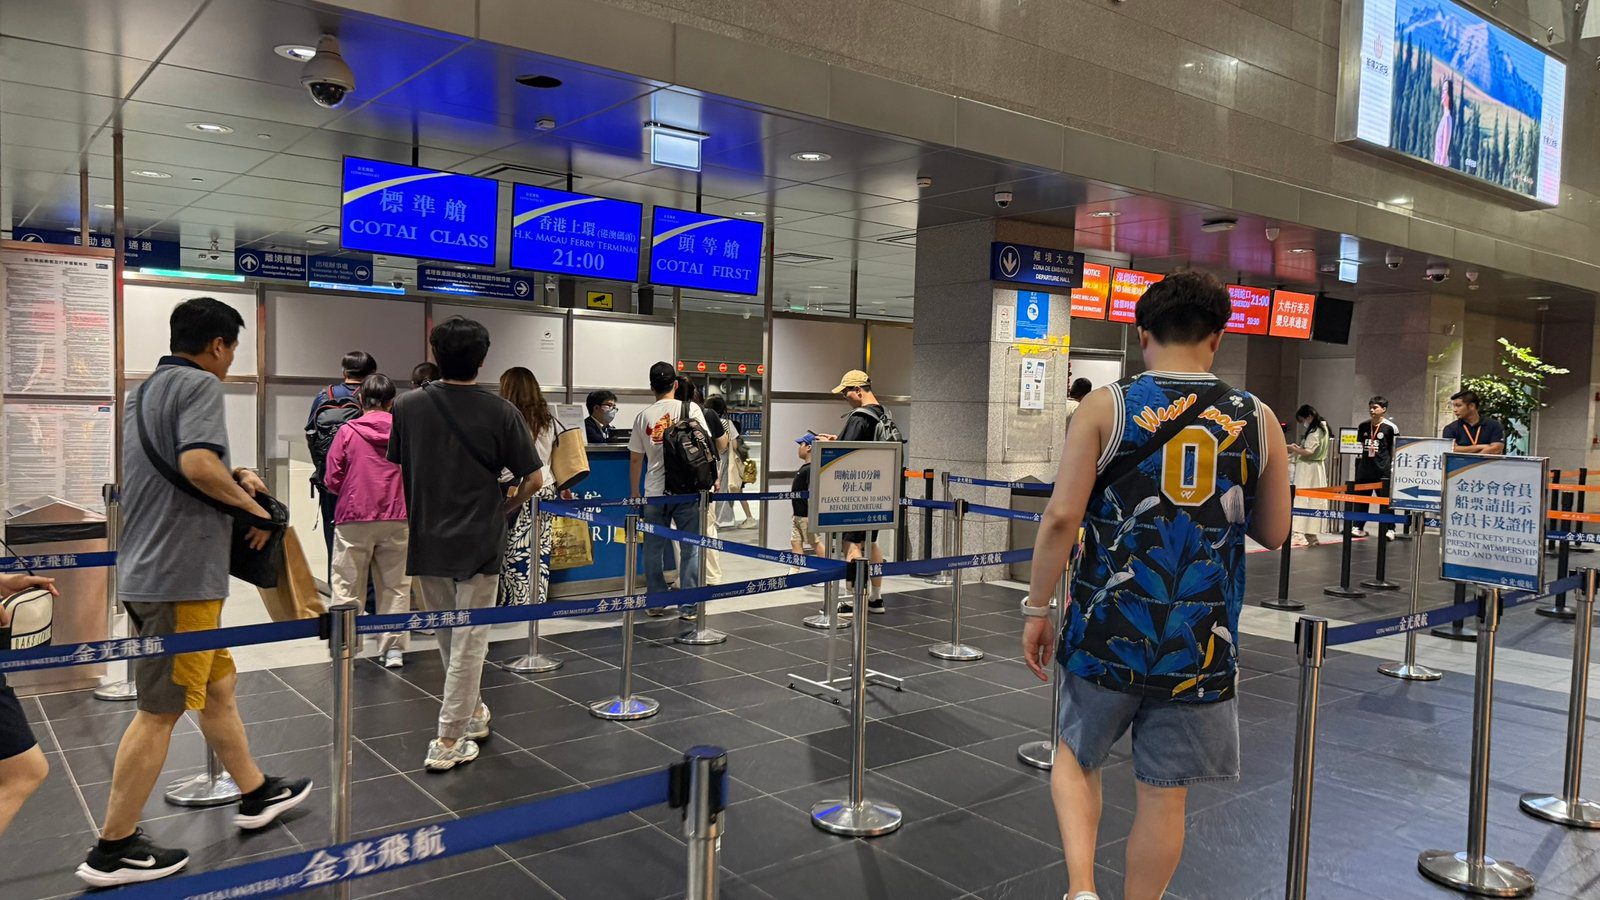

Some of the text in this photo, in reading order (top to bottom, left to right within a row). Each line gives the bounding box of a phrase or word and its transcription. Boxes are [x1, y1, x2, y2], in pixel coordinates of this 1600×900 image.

[380, 188, 468, 223] 標準艙
[350, 219, 489, 249] COTAI CLASS
[535, 233, 568, 245] MACAU
[570, 237, 596, 249] FERRY
[597, 241, 638, 254] TERMINAL
[678, 233, 740, 259] 頭等艙
[552, 248, 605, 271] 21:00
[656, 258, 752, 280] COTAI FIRST
[1035, 273, 1060, 282] DEPARTURE
[1250, 294, 1270, 307] 21:00
[1277, 301, 1310, 315] 大件行李及
[1395, 476, 1441, 486] HONGKON
[1456, 478, 1533, 499] 金沙會會員
[821, 496, 840, 504] PLEASE
[829, 502, 883, 511] BEFORE DEPARTURE
[1455, 494, 1532, 515] 船票請出示
[1450, 511, 1537, 534] 會員卡及證件
[1447, 528, 1537, 547] SRC TICKETS PLEASE
[1445, 547, 1470, 557] CARD
[1472, 551, 1492, 560] AND
[1494, 554, 1522, 564] VALID
[1446, 539, 1538, 556] PRESENT MEMBERSHIP
[746, 577, 788, 594] 金光飛航
[596, 595, 647, 613] 金光飛航
[406, 610, 472, 629] 金光飛航
[72, 636, 165, 664] 金光飛航
[300, 825, 447, 888] 金光飛航
